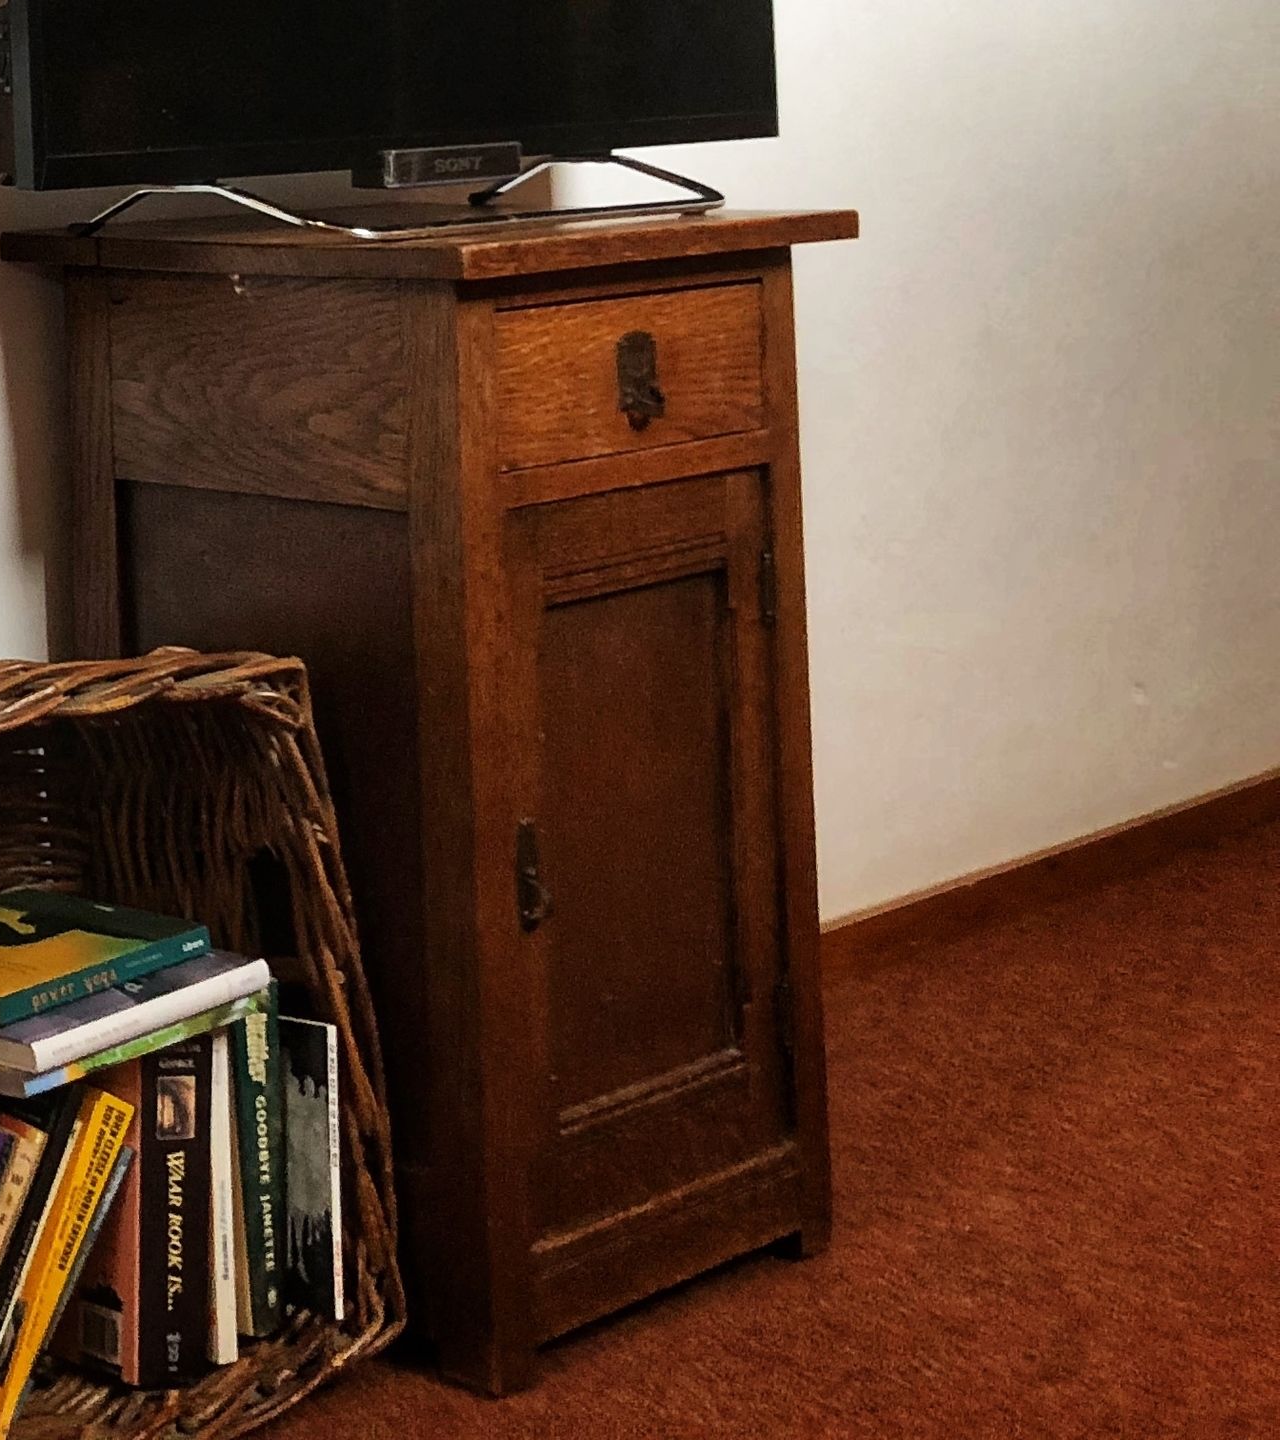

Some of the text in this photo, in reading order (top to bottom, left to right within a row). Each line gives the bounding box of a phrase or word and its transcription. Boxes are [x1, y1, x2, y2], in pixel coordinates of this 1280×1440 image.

[433, 156, 483, 173] SONY
[109, 1110, 127, 1138] JOHN
[254, 1094, 272, 1185] GOODBYE
[94, 1138, 116, 1176] CLEESE
[165, 1150, 186, 1208] WAAR
[167, 1212, 184, 1270] ROOK
[259, 1193, 276, 1272] JANETTE
